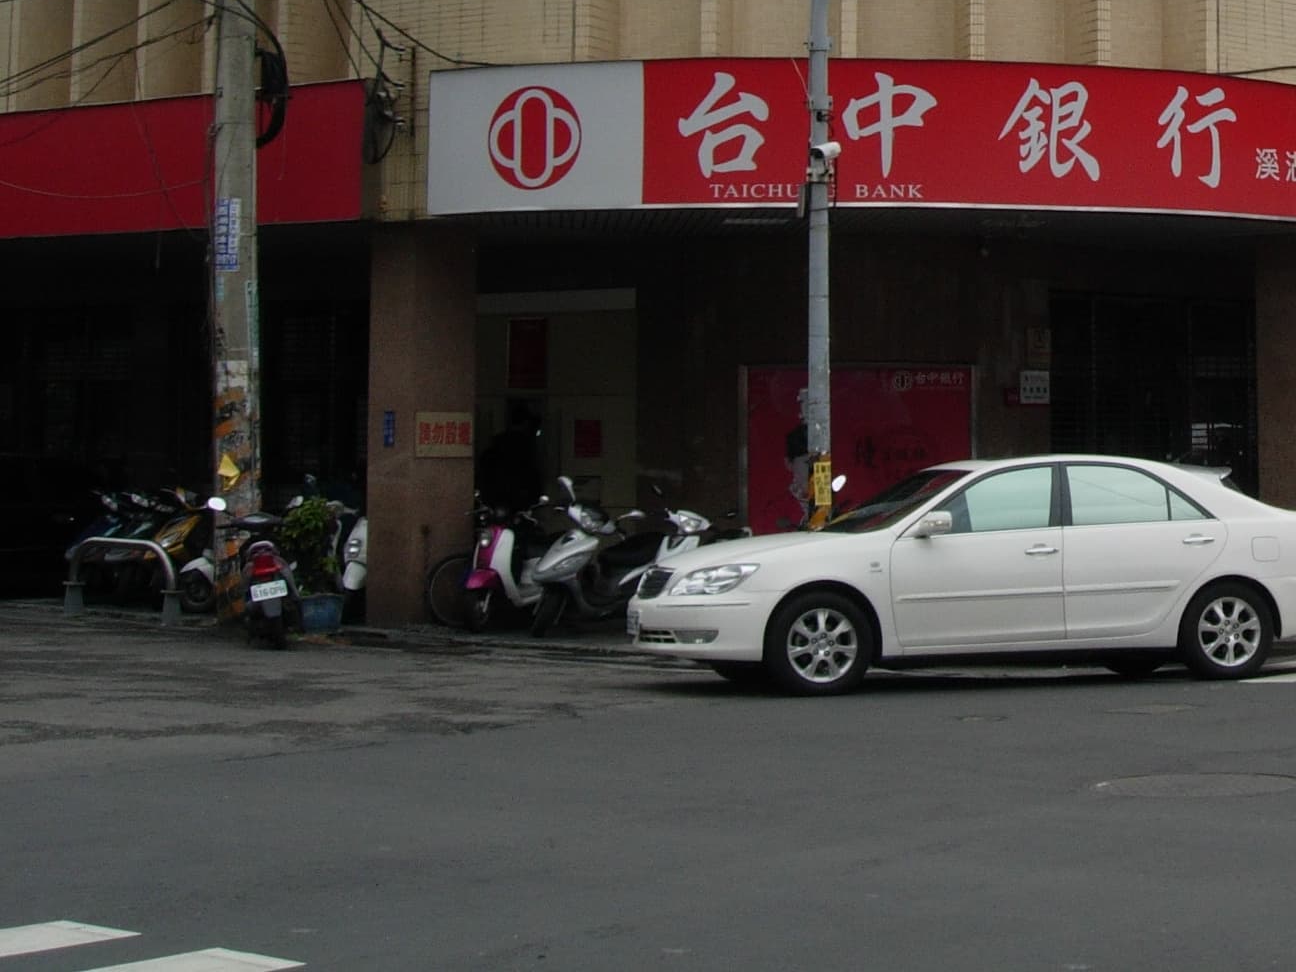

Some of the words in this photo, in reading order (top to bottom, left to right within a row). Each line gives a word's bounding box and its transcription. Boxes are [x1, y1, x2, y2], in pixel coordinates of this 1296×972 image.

[677, 72, 1238, 188] 台中銀行
[709, 183, 836, 199] TAICHU
[855, 183, 924, 199] BANK
